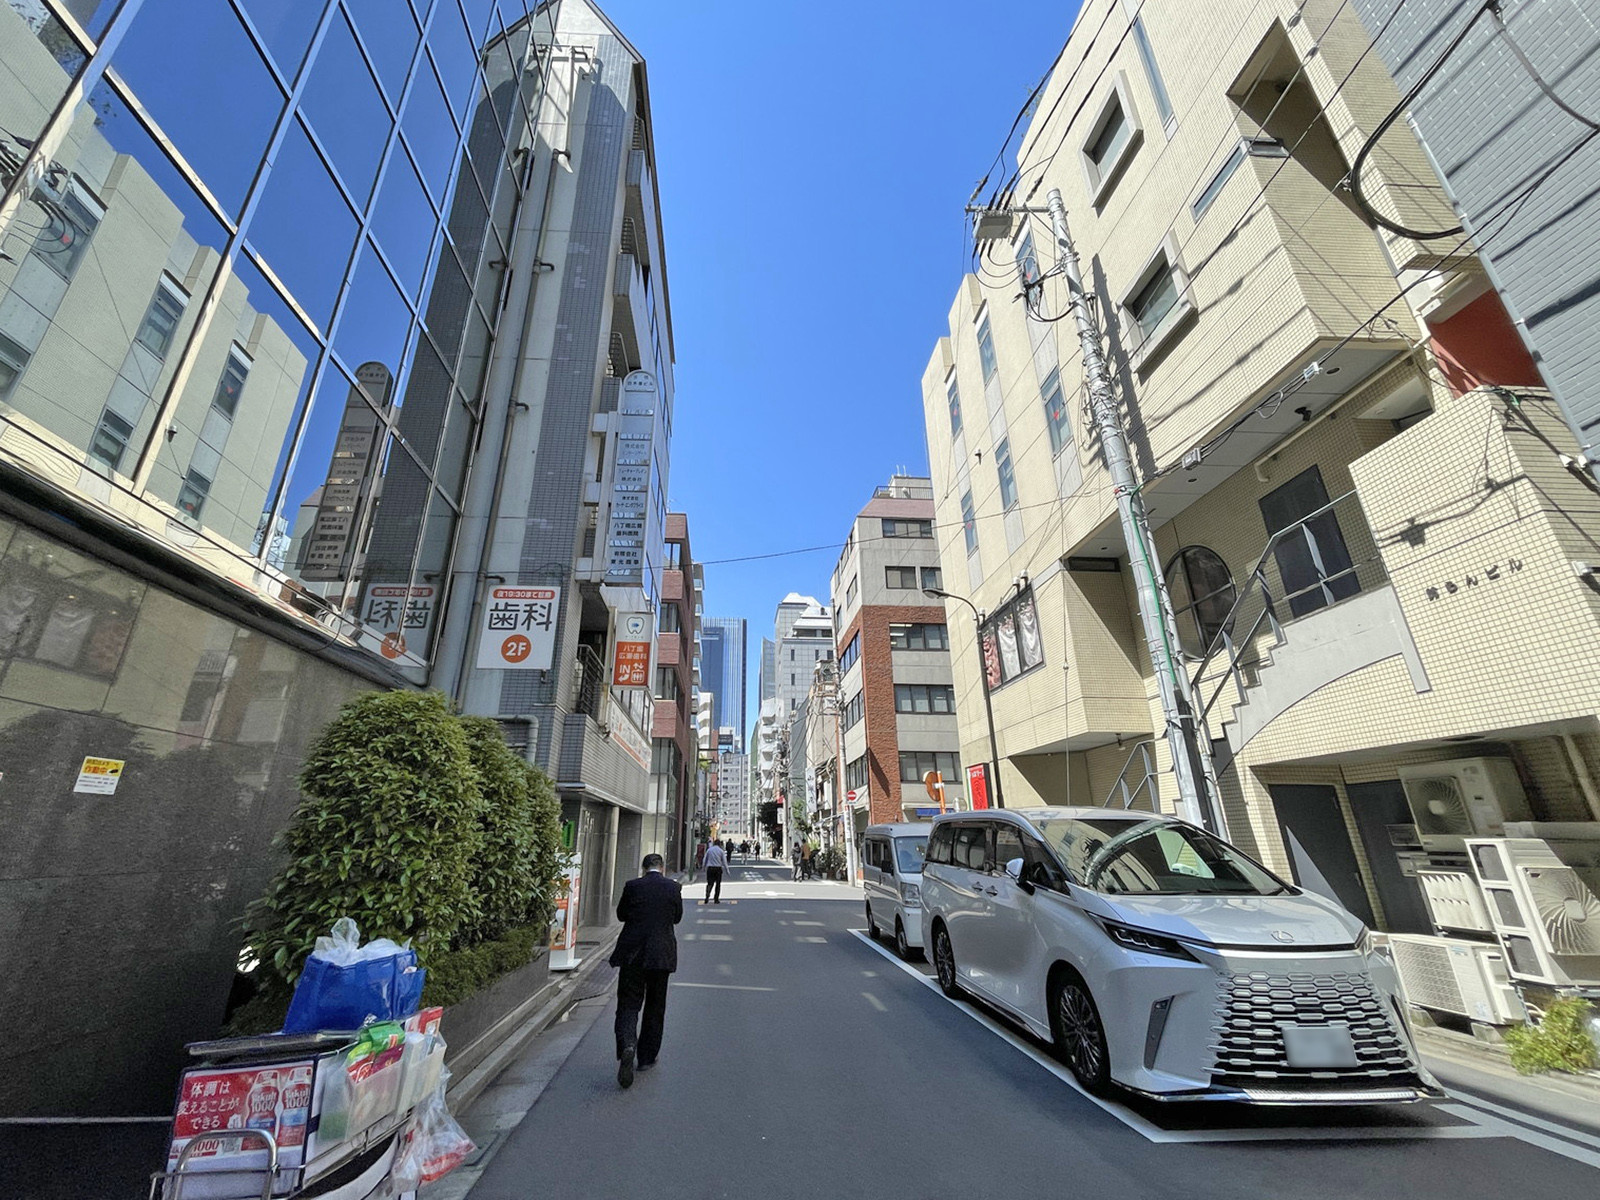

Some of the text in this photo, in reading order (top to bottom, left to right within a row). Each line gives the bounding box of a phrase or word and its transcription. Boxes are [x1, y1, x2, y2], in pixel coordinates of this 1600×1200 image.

[488, 602, 552, 631] 歯科
[506, 642, 527, 656] 2F
[620, 664, 631, 674] IN
[191, 1080, 231, 1097] 体調は
[177, 1098, 240, 1116] 変えることが
[251, 1100, 275, 1113] 1000
[191, 1116, 221, 1129] できる
